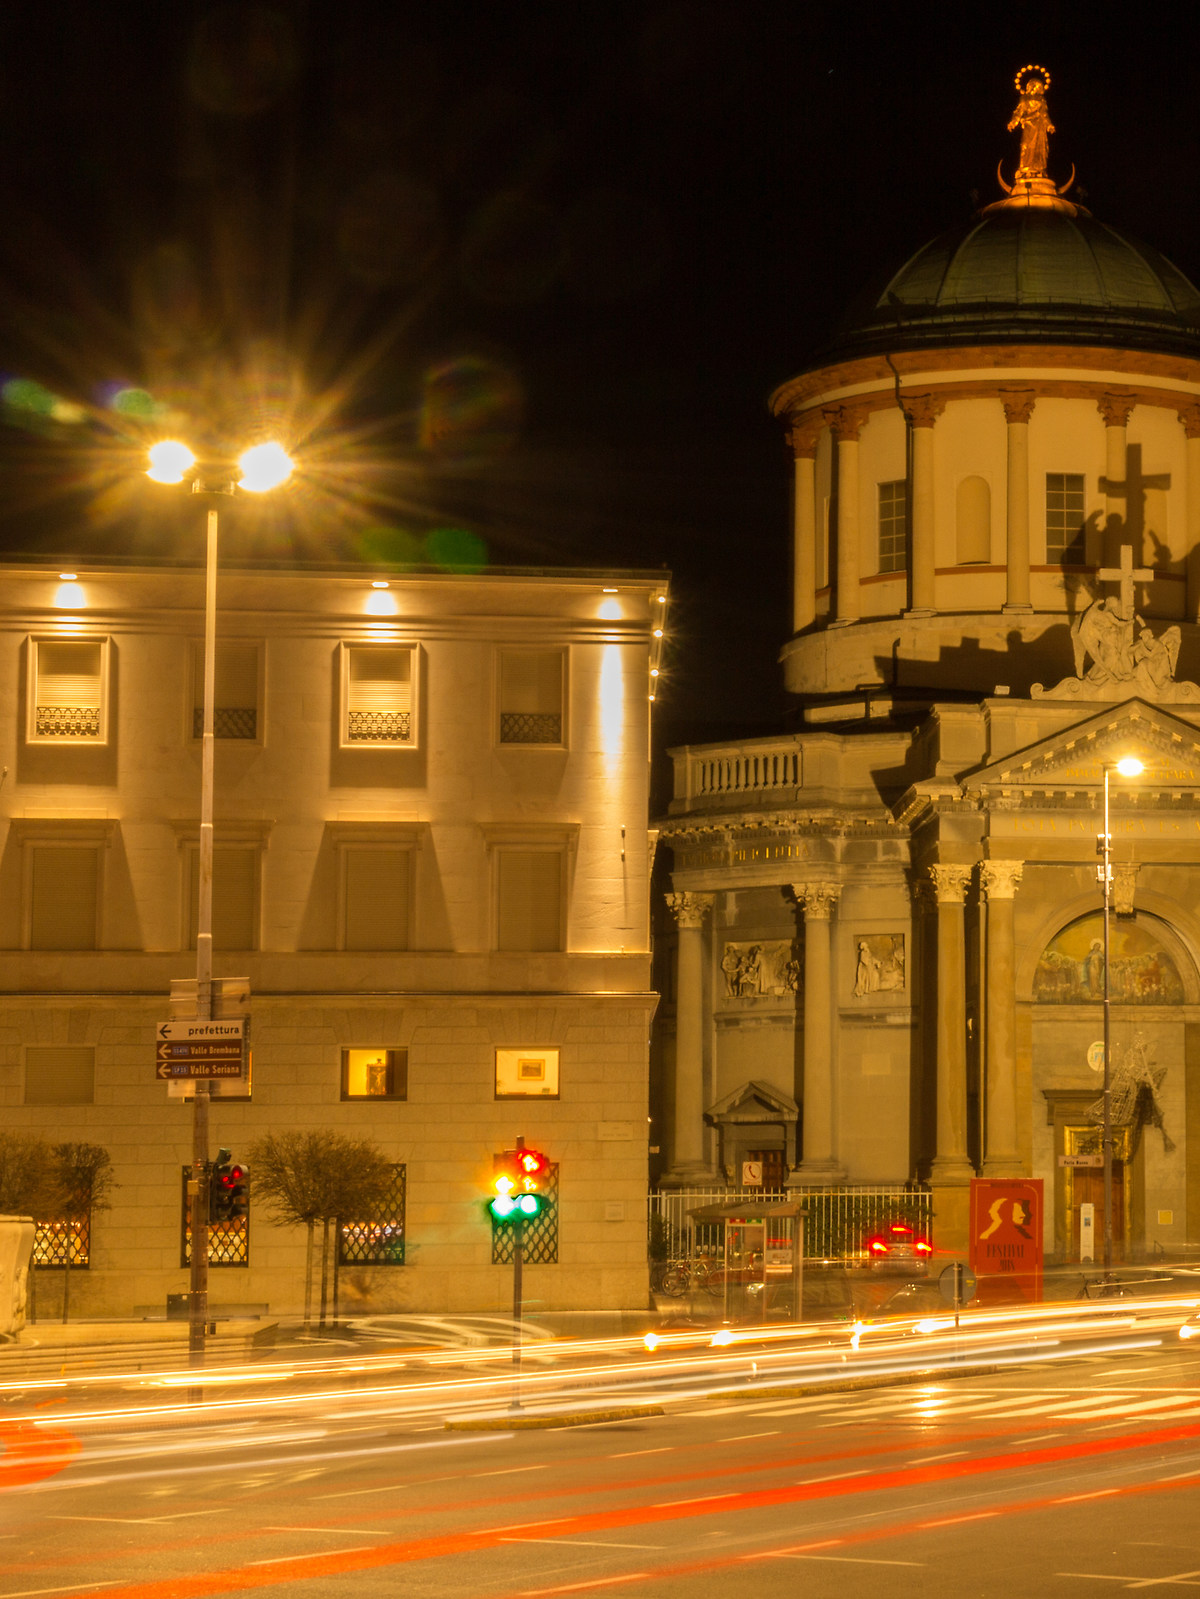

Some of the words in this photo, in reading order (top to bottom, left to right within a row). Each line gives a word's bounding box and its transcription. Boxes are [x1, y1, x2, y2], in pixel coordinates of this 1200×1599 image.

[1068, 818, 1148, 832] PVLHRA
[188, 1025, 240, 1036] prefettura
[190, 1046, 208, 1055] Valle
[209, 1045, 240, 1054] Brembana
[190, 1064, 210, 1075] Valle
[212, 1063, 240, 1074] Seriana
[986, 1243, 1025, 1258] FESTIVAL
